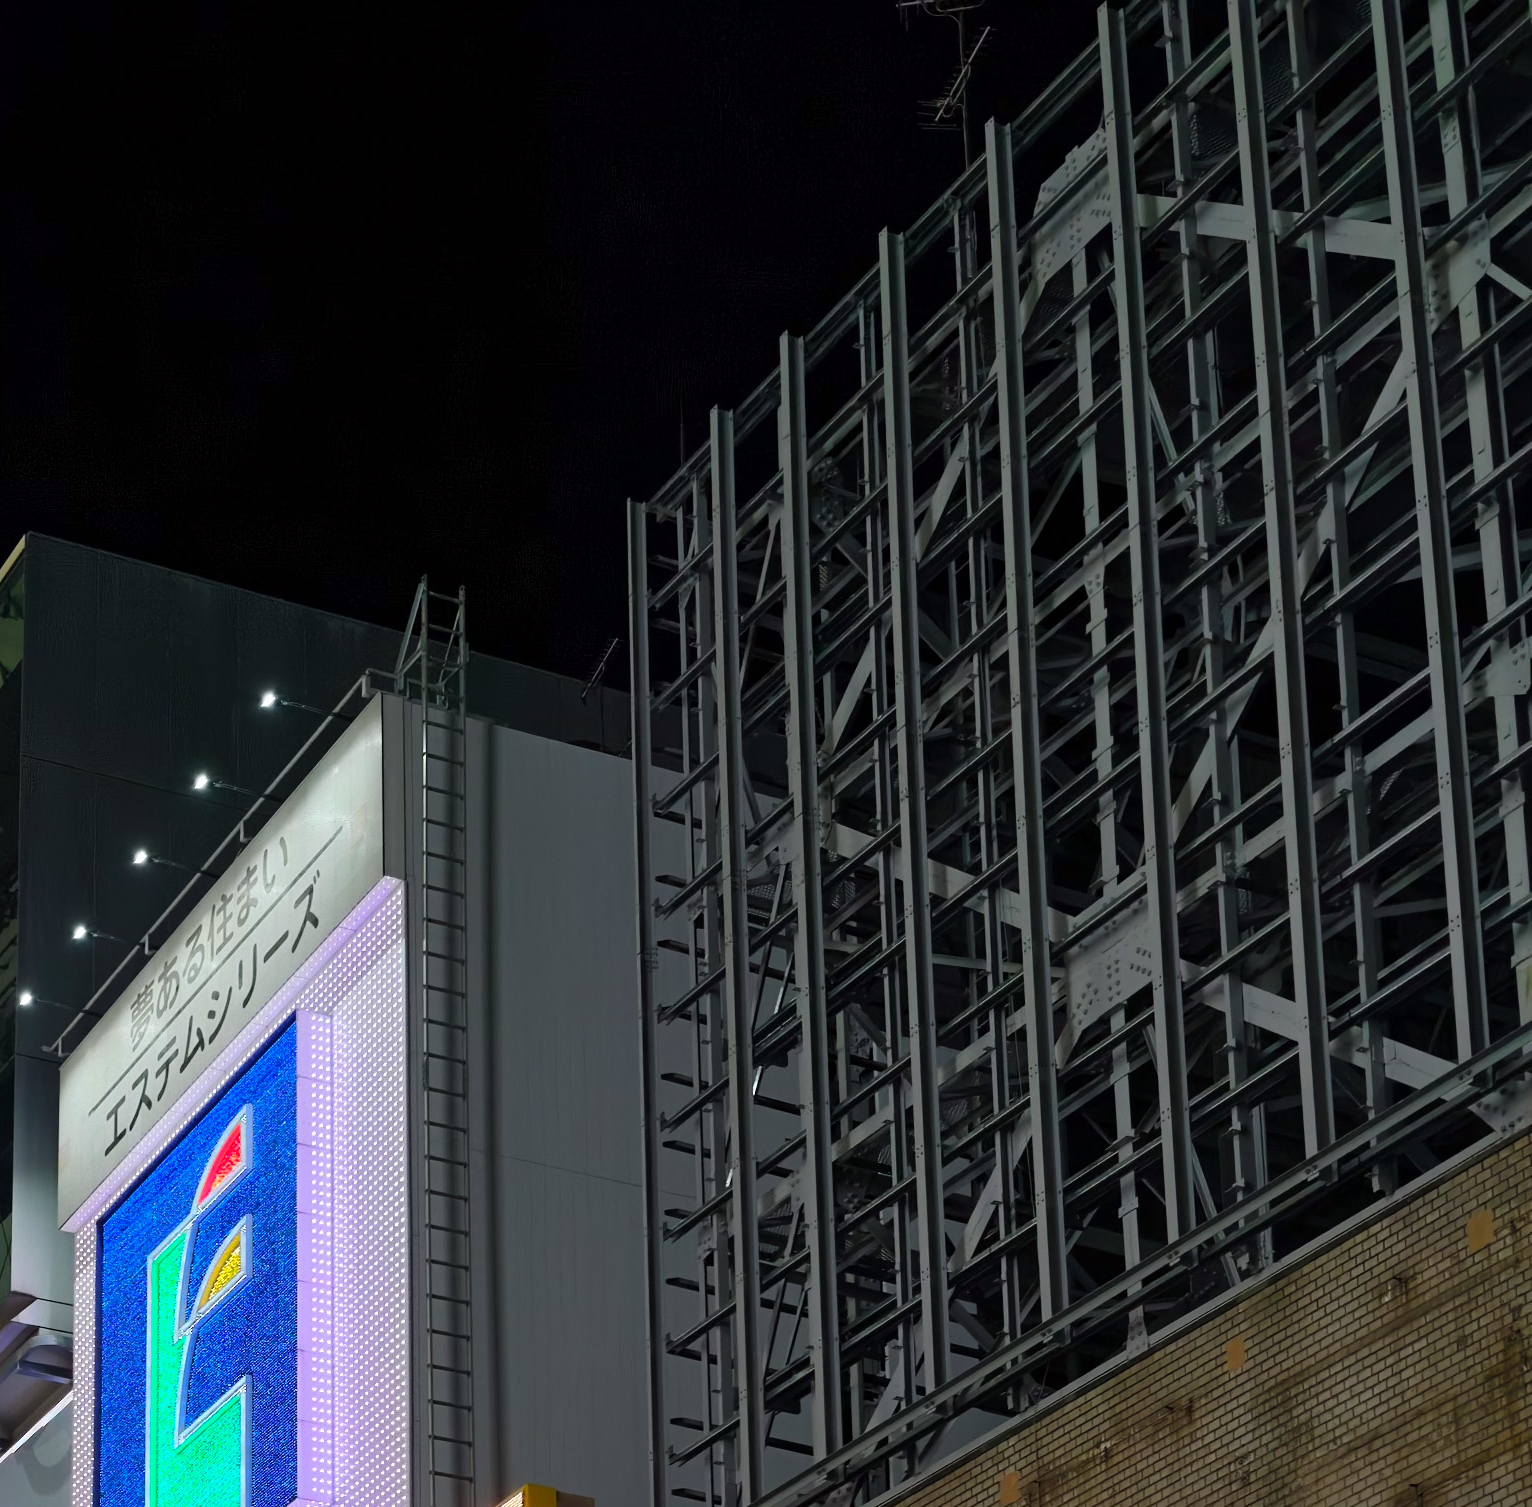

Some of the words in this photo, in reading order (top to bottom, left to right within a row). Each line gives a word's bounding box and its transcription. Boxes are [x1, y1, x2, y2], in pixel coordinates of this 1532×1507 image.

[105, 868, 323, 1156] エステムシリーズ
[130, 838, 290, 1046] 夢ある住まい
